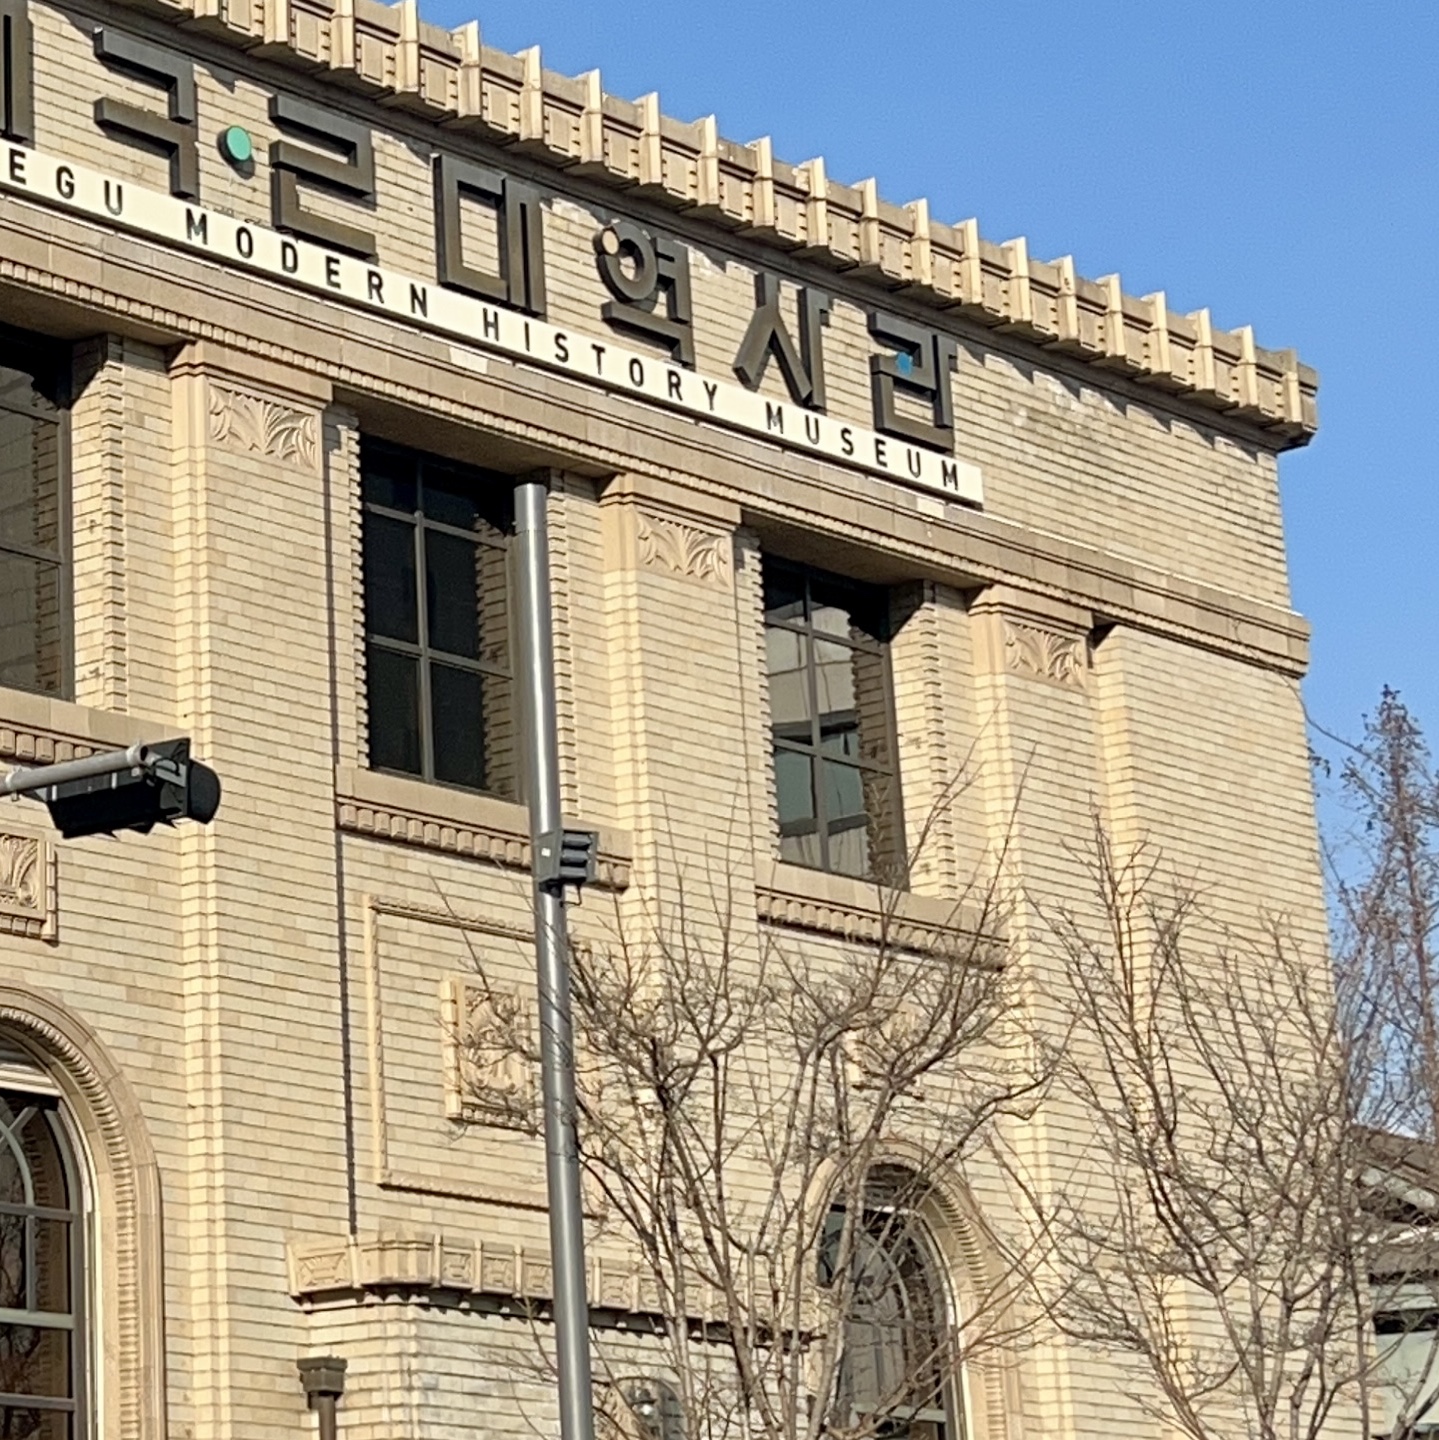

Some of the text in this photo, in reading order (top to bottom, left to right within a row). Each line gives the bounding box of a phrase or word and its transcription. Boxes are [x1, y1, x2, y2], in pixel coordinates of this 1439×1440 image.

[186, 208, 429, 319] MODERN
[482, 306, 718, 412] HISTORY
[765, 399, 959, 492] MUSEUM
